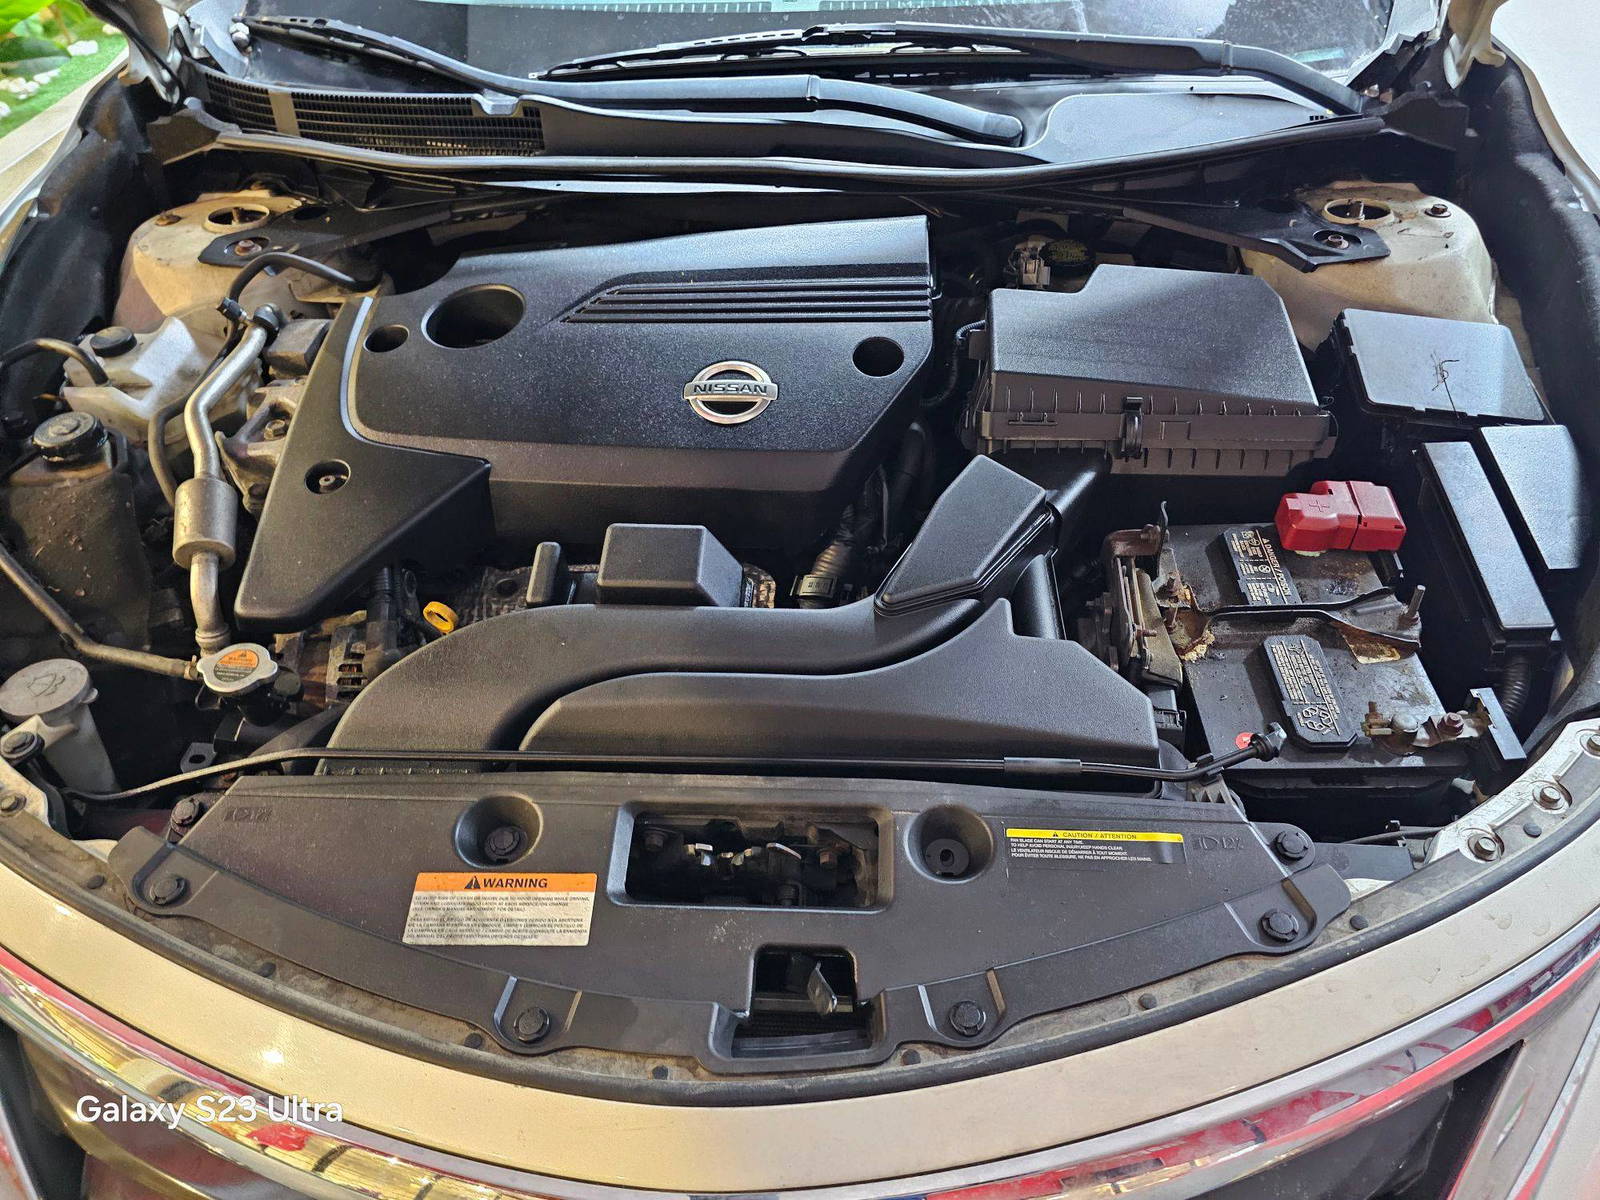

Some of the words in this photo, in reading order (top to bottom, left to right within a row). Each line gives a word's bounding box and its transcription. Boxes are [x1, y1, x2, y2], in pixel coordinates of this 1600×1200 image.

[693, 383, 768, 394] NISSAN
[1100, 832, 1137, 840] ATTENTION
[483, 878, 548, 888] WARNING
